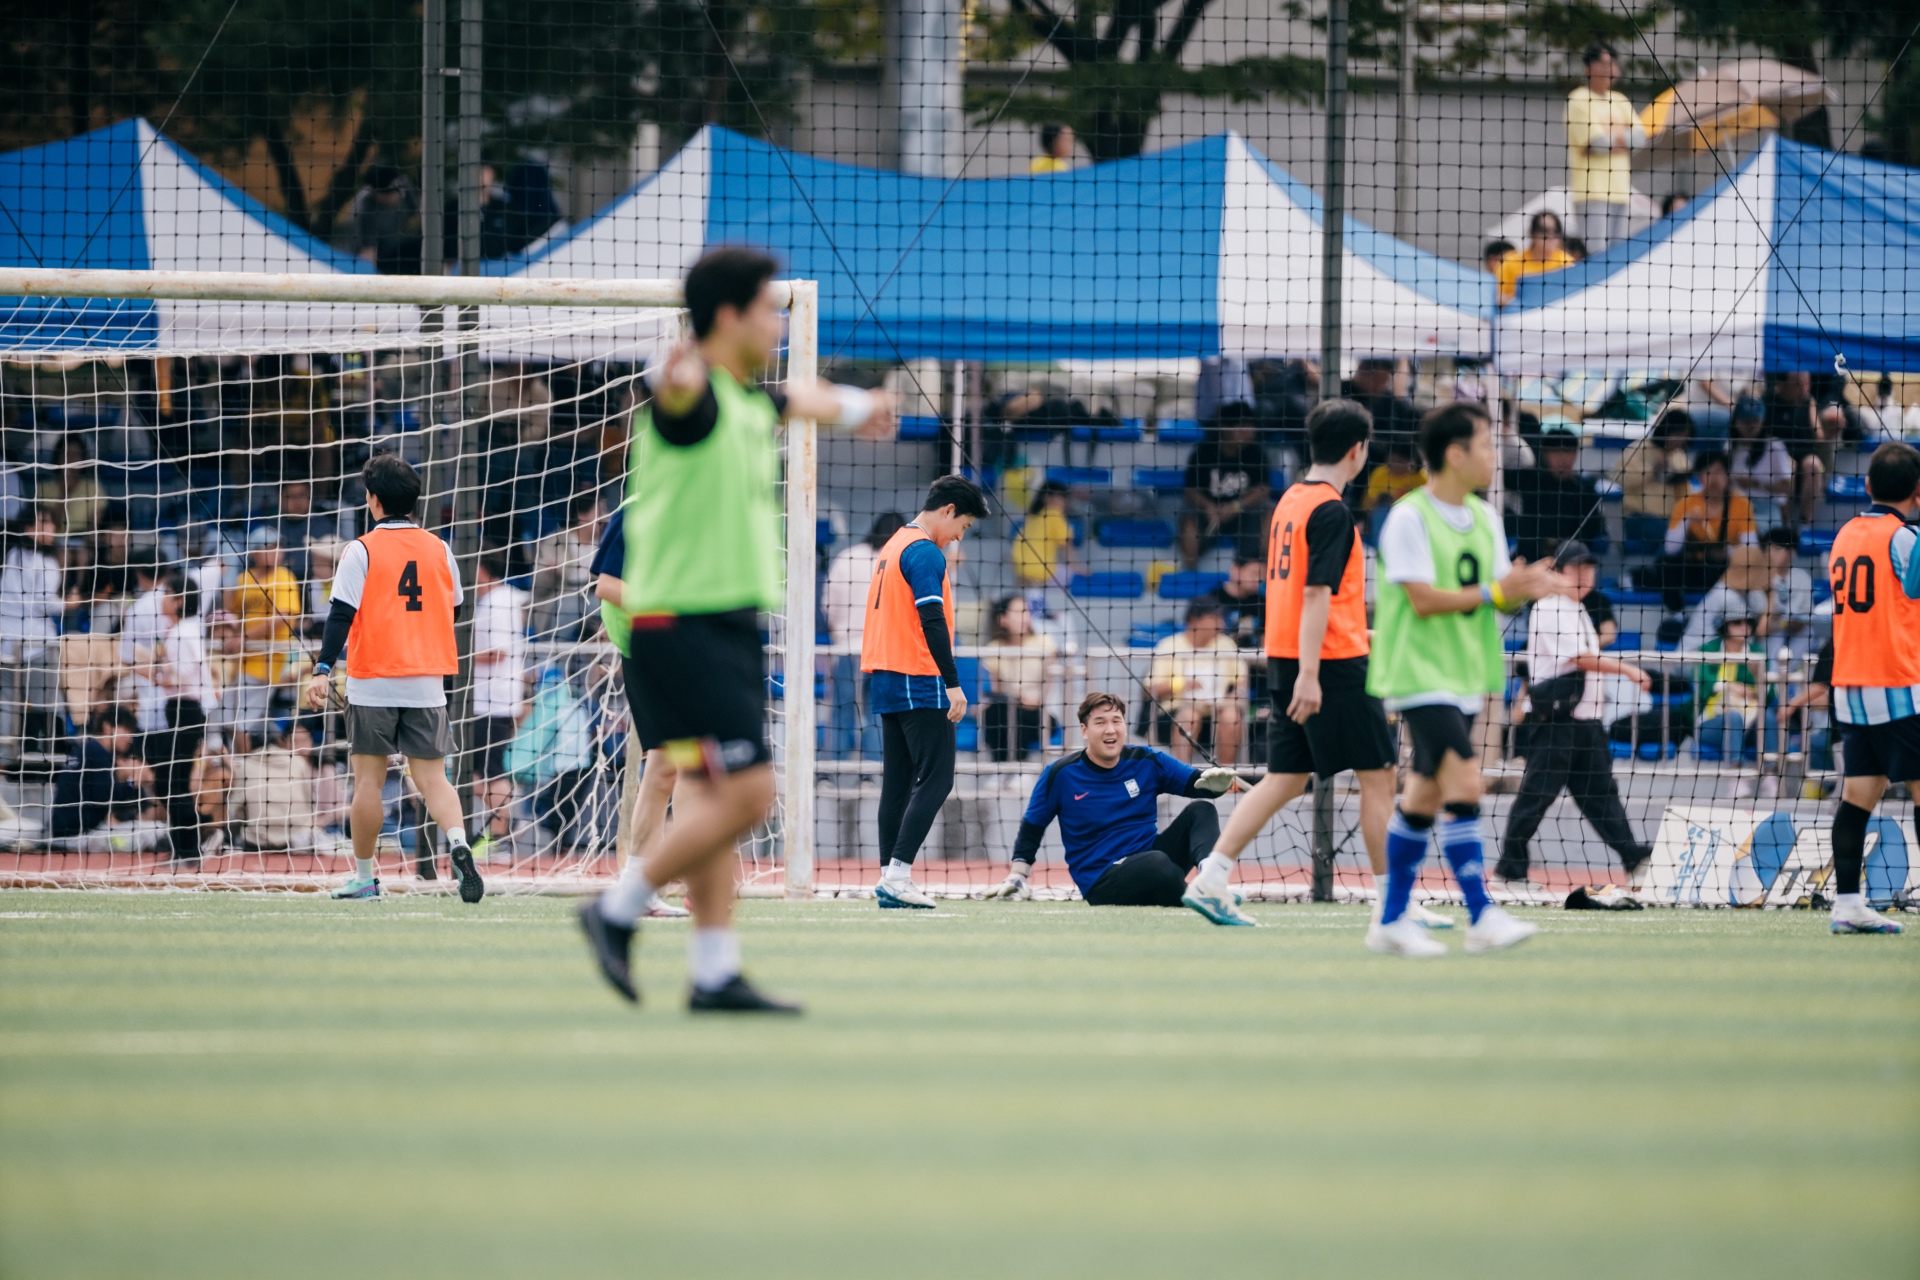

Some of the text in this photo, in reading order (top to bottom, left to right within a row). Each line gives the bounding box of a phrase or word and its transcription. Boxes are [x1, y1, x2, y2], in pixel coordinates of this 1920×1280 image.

[1270, 521, 1293, 580] 18
[397, 560, 423, 612] 4
[874, 559, 888, 610] 7
[1832, 555, 1875, 614] 20
